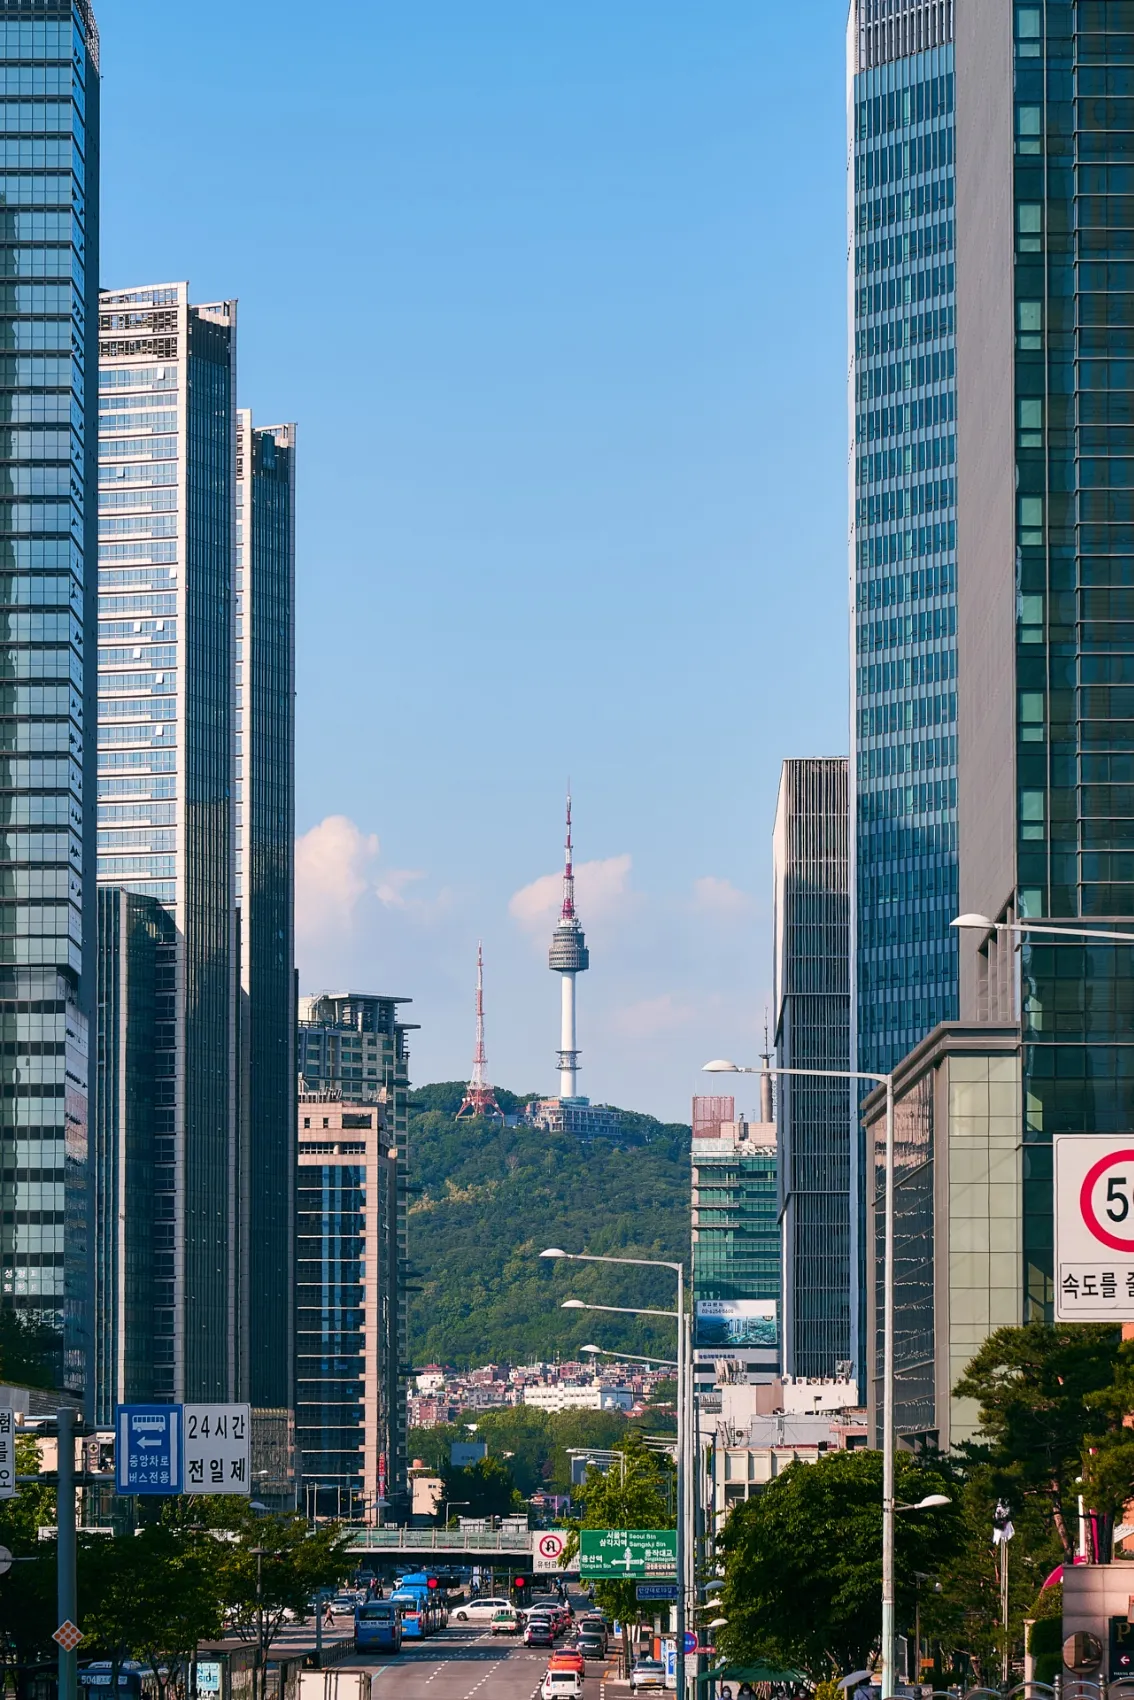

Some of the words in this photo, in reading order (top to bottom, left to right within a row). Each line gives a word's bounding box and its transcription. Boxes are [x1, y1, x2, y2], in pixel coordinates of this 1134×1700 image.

[1106, 1177, 1134, 1223] 5
[1061, 1271, 1118, 1300] 속도를
[188, 1414, 245, 1440] 24시간
[129, 1454, 170, 1468] 중앙차로
[129, 1470, 170, 1484] 버스전용
[188, 1457, 245, 1483] 전일제
[606, 1531, 627, 1540] 서울역
[599, 1539, 627, 1547] 삼각지역
[581, 1555, 603, 1563] 용산역
